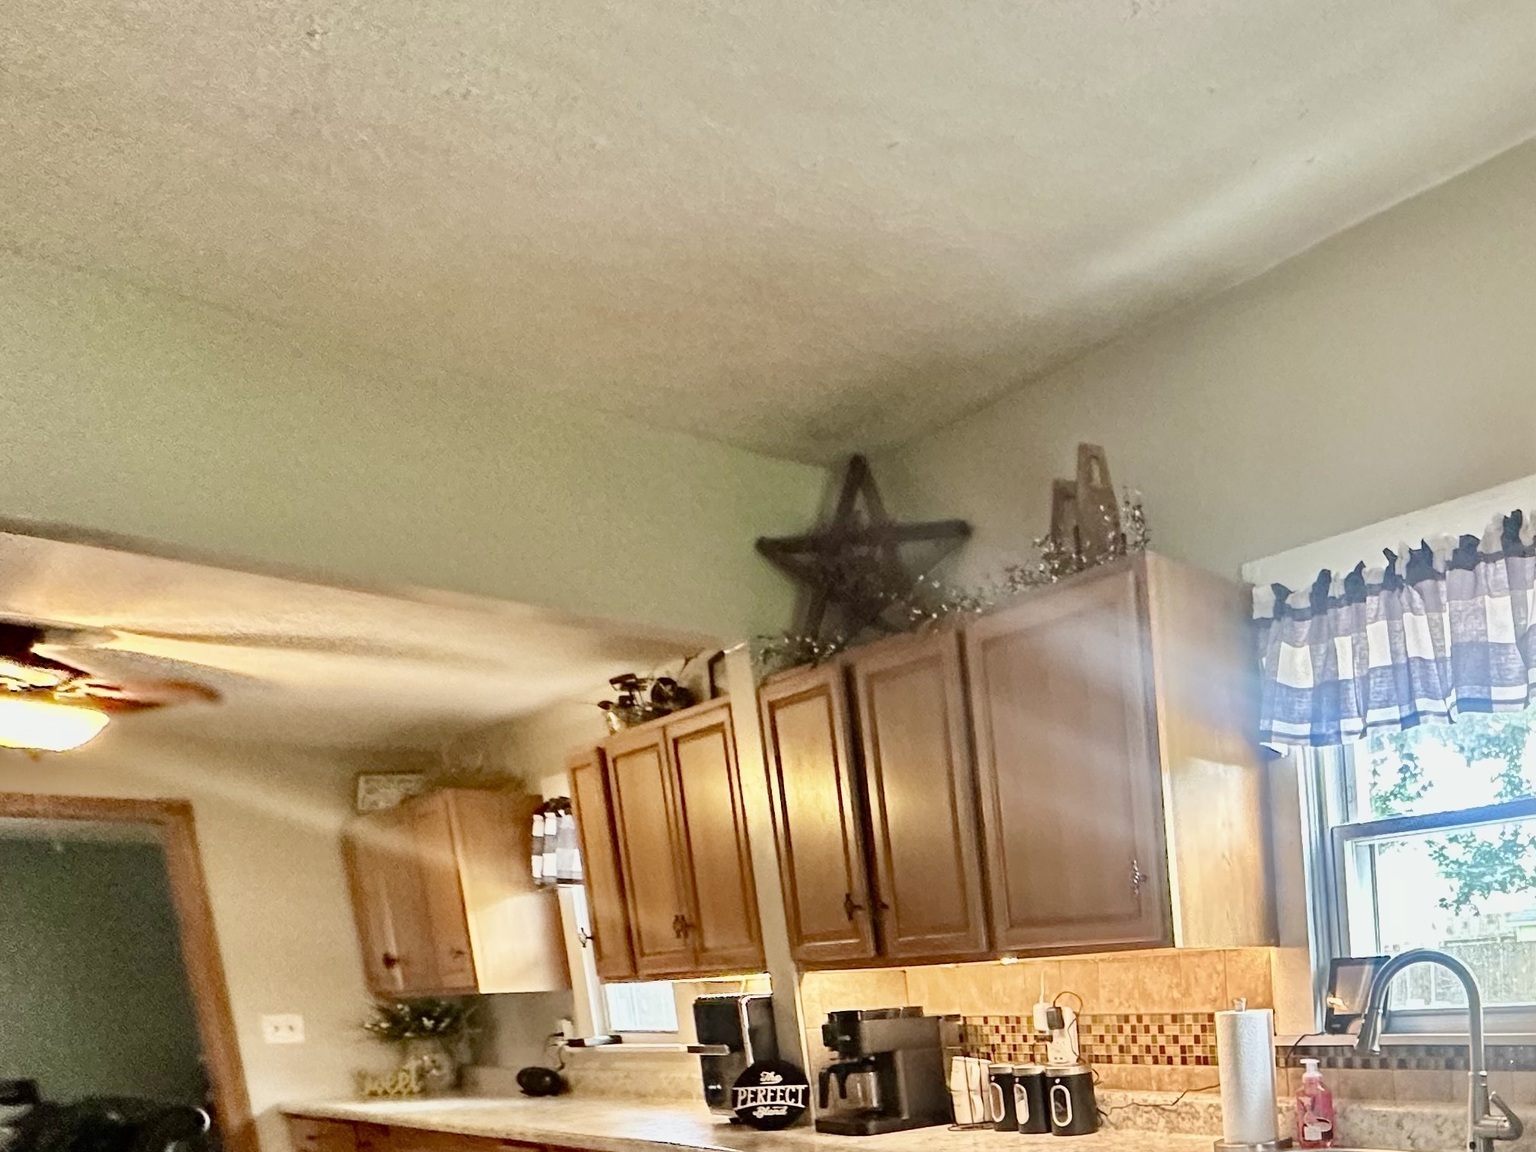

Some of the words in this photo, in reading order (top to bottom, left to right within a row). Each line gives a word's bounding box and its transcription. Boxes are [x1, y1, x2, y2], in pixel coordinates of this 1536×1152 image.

[759, 1070, 783, 1085] The
[733, 1084, 808, 1111] PERFECT
[752, 1105, 788, 1119] Blend
